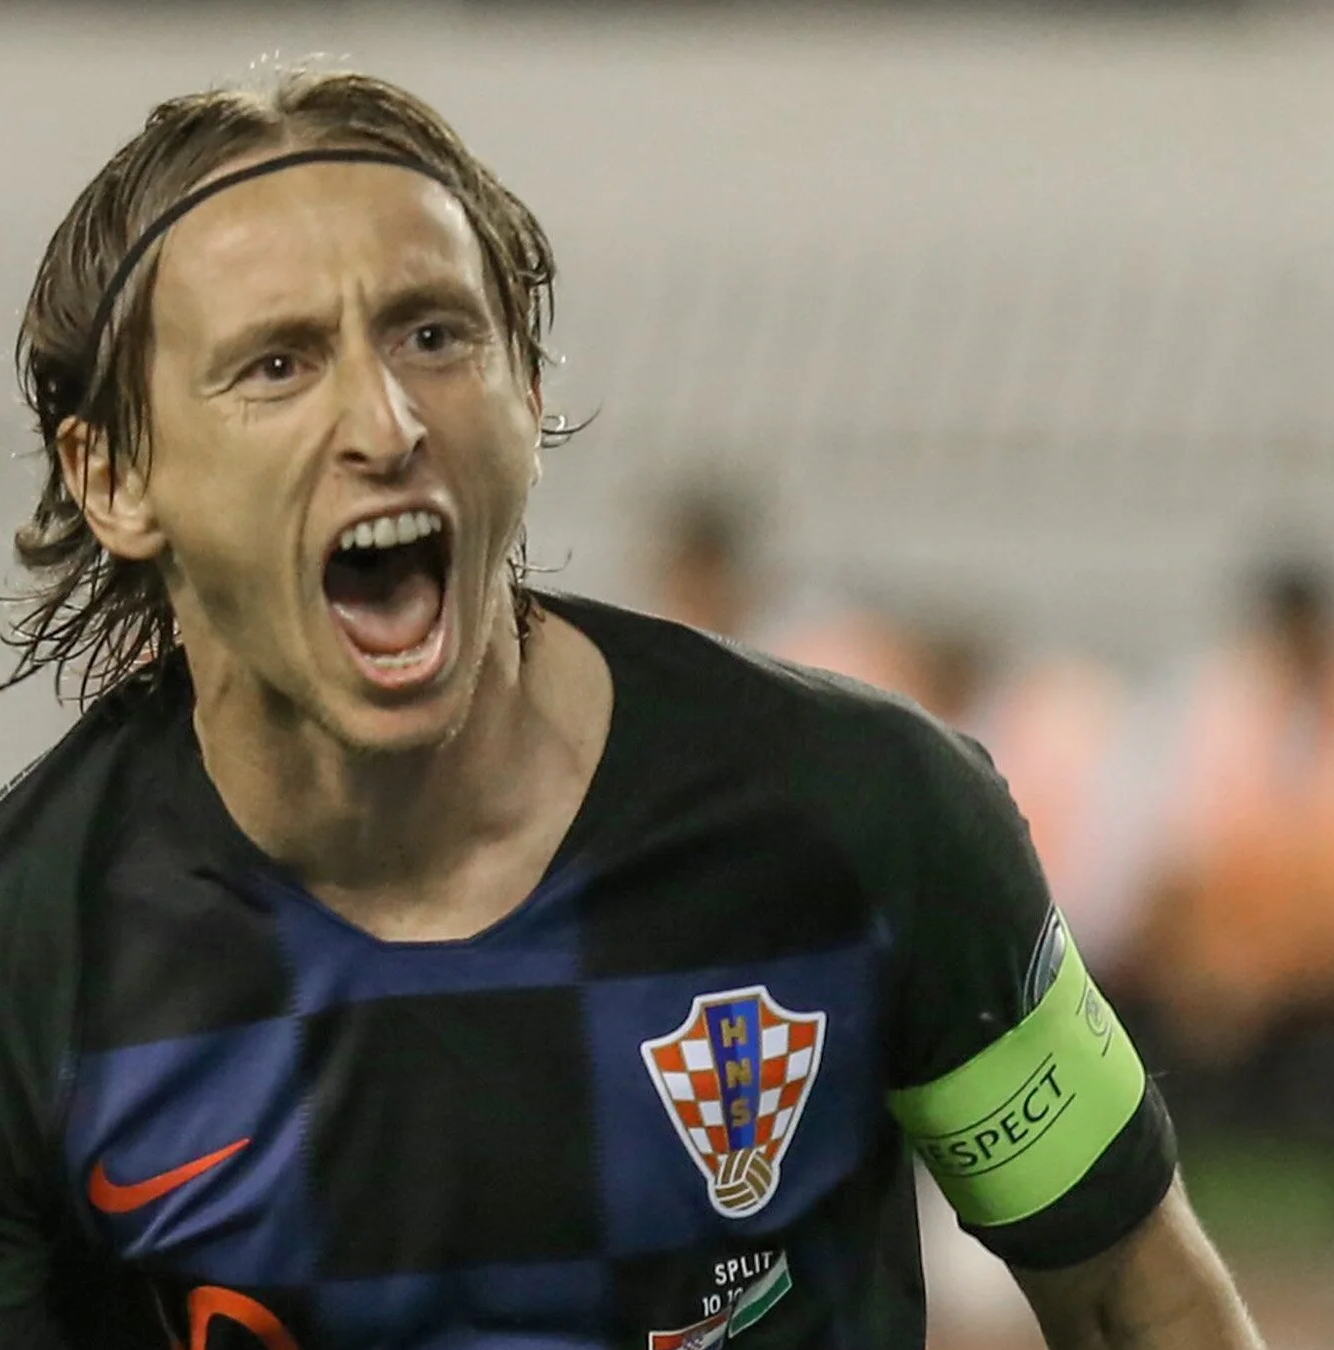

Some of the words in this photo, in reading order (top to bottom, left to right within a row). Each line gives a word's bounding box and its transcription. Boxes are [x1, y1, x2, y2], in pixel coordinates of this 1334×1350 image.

[720, 1016, 753, 1127] HNS
[919, 1063, 1063, 1169] ESPECT
[714, 1250, 774, 1285] SPLIT
[701, 1294, 722, 1317] 10
